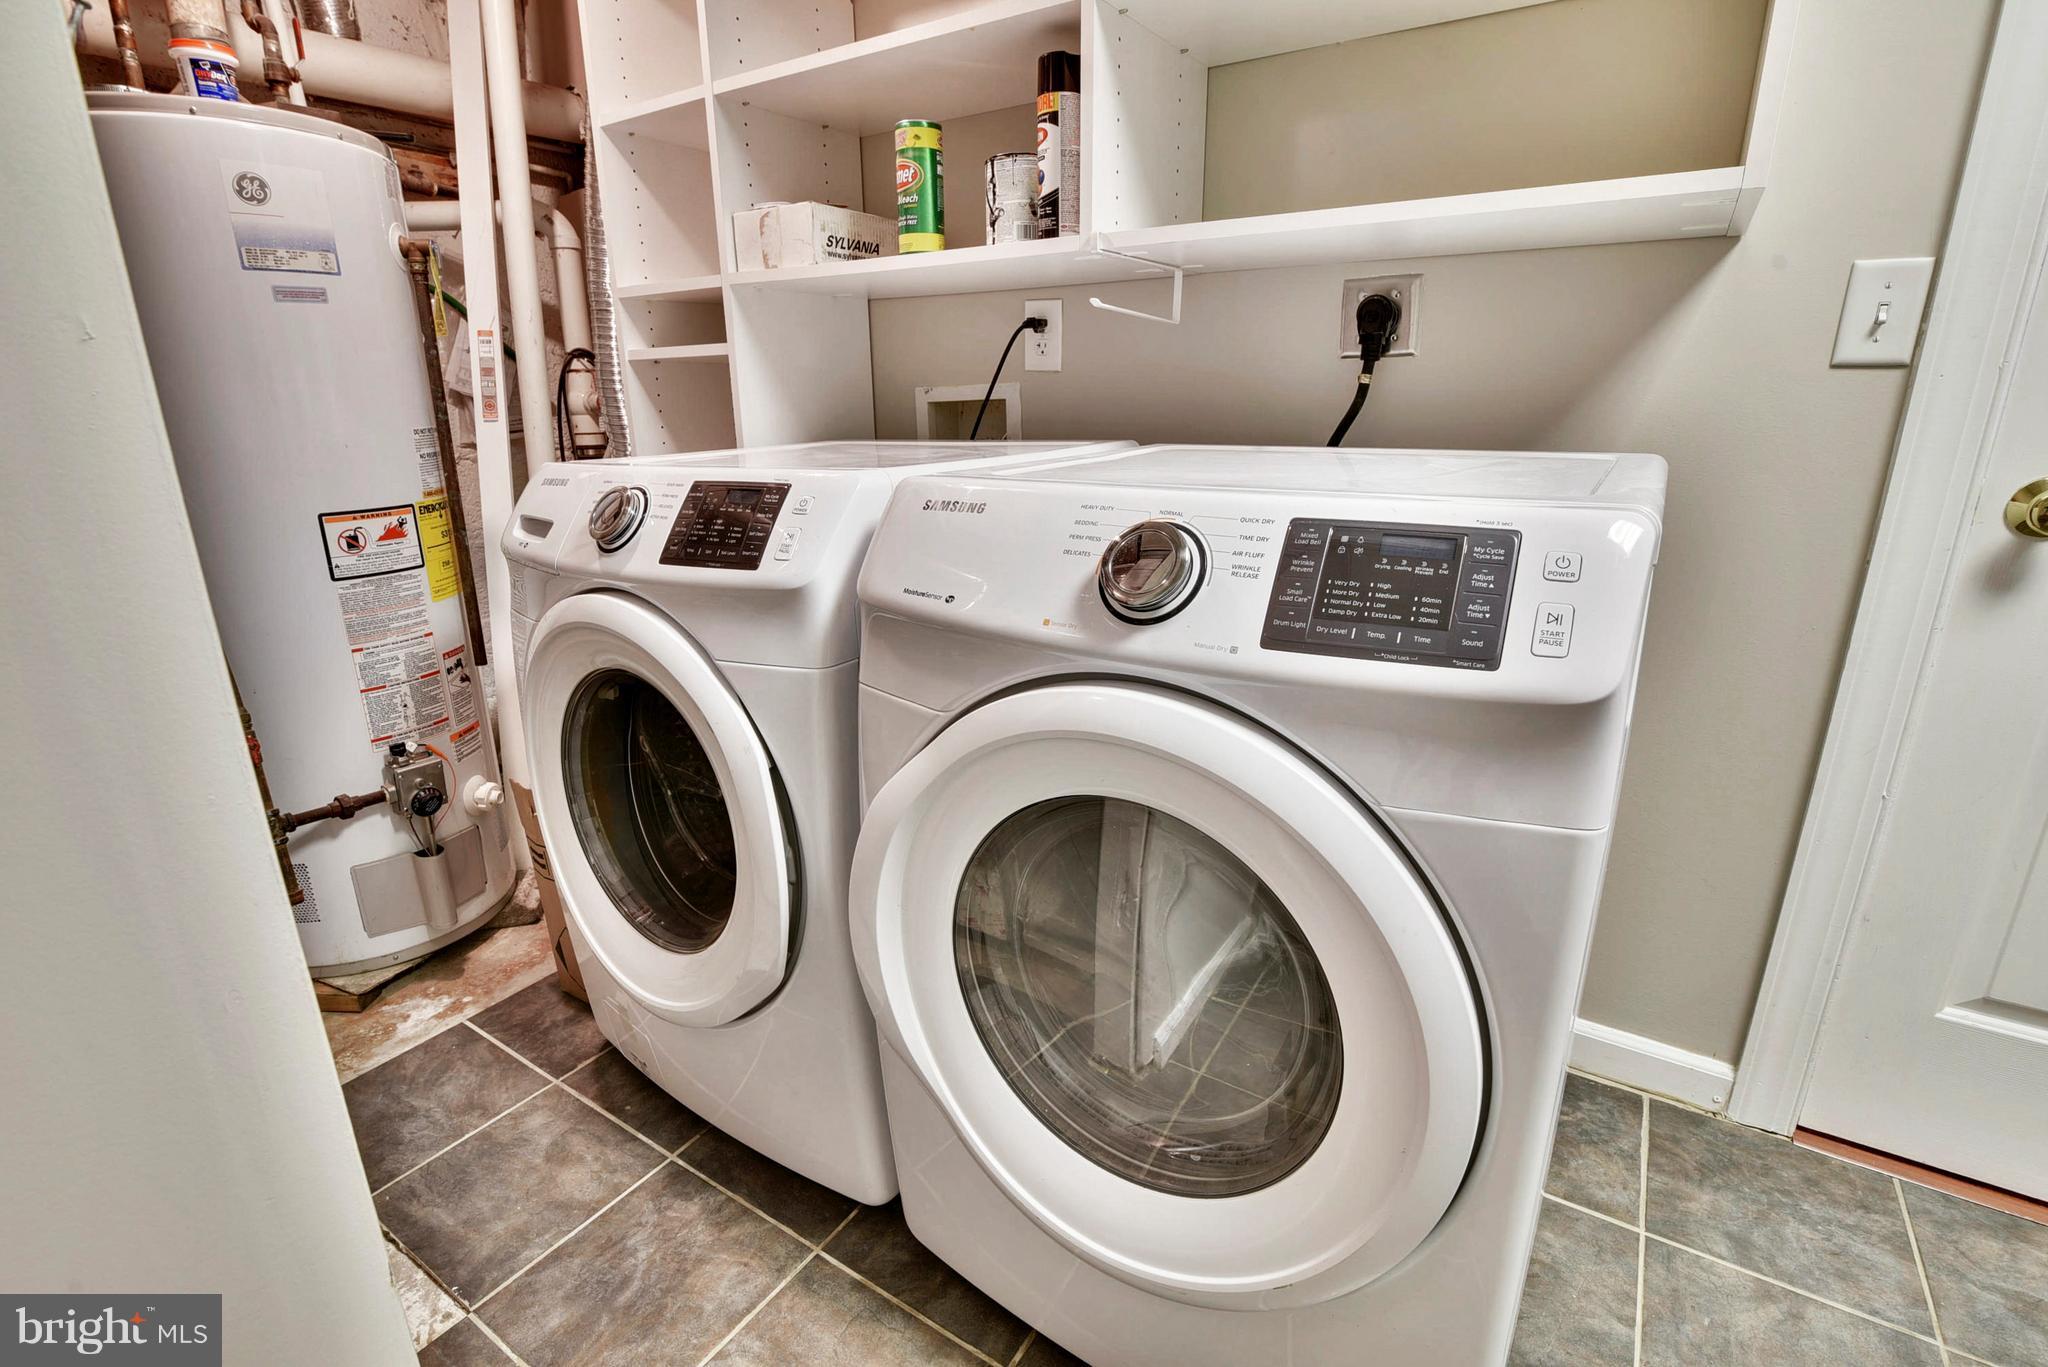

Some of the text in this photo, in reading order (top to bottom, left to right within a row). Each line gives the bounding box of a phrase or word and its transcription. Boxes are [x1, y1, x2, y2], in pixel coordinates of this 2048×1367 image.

[896, 166, 915, 184] met
[826, 234, 880, 256] SYLVANIA
[541, 478, 570, 487] SAMSUNG
[922, 499, 987, 514] SAMSUNG
[1159, 510, 1184, 518] NORMAL
[1074, 519, 1099, 527] BEDDING
[1062, 549, 1091, 557] DELICATES
[1473, 546, 1505, 555] My Cycle
[1231, 564, 1261, 573] WRINKLE
[1230, 571, 1259, 579] RELEASE
[1472, 573, 1494, 582] Adjust
[1547, 570, 1576, 578] POWER
[1377, 582, 1392, 590] High
[1471, 580, 1488, 588] Time
[902, 587, 943, 601] MoistureSensor
[1375, 592, 1400, 600] Medium
[1330, 598, 1364, 608] Normal Dry
[1421, 596, 1442, 604] 60min
[1328, 608, 1345, 616] Damp
[1419, 606, 1440, 614] 40min
[1467, 604, 1490, 612] Adjust
[1466, 611, 1484, 619] Time
[1273, 618, 1306, 629] Drum Light
[1418, 616, 1439, 624] 20min
[1316, 626, 1348, 635] Dry Level
[1540, 629, 1565, 638] START
[1367, 631, 1386, 640] Temp.
[1414, 635, 1432, 644] Time
[1194, 641, 1229, 653] Manual Dry
[1461, 639, 1484, 648] Sound
[1538, 639, 1565, 647] PAUSE
